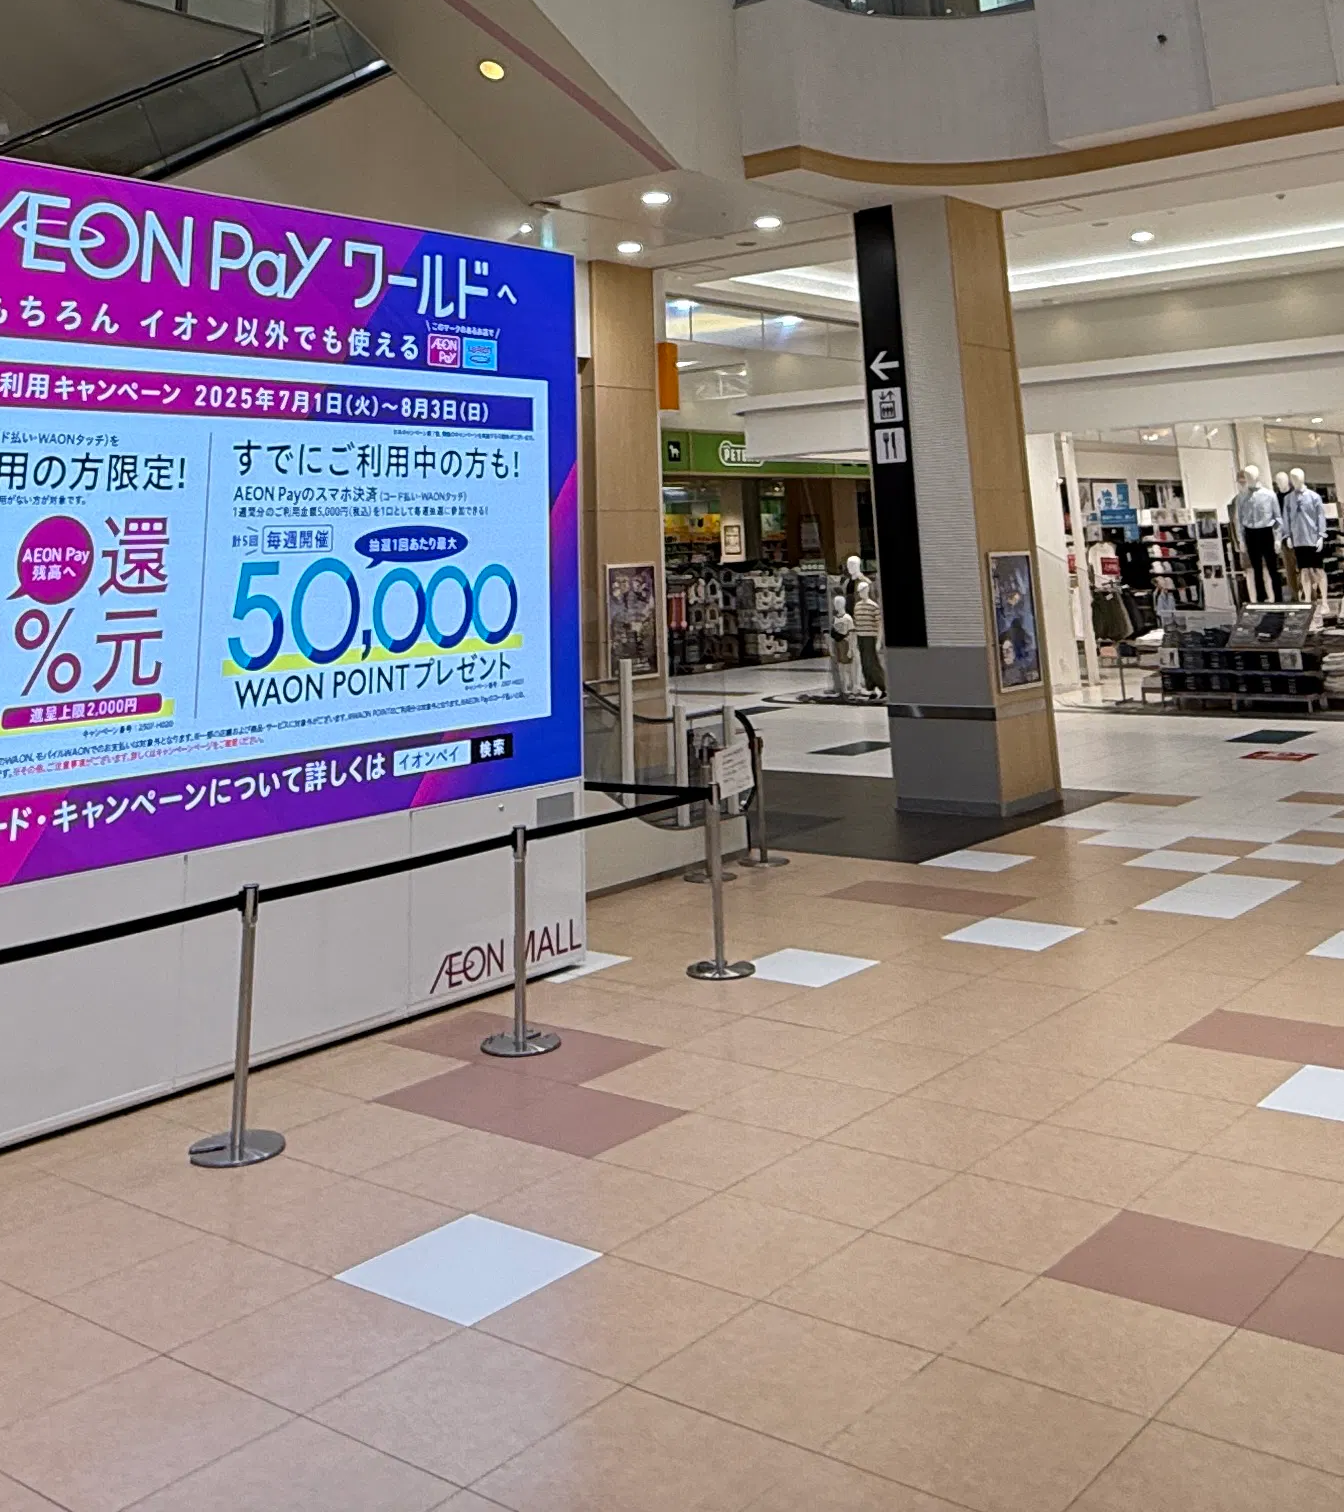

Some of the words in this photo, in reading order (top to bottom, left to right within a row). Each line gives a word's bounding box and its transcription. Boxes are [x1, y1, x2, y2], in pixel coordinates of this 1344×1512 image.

[210, 210, 333, 300] Pay
[140, 308, 420, 363] イオン以外でも使える
[439, 350, 457, 364] Pay
[232, 439, 520, 480] すでにご利用中の方も!
[724, 448, 760, 462] PETE
[233, 486, 275, 502] AEON
[232, 534, 259, 548] 計5回
[267, 530, 330, 550] 毎週開催
[368, 536, 458, 553] 抽選1回あたり最大
[22, 548, 61, 564] AEON
[64, 549, 91, 568] Pay
[31, 564, 77, 582] 残高へ
[227, 556, 519, 672] 50,000
[235, 672, 325, 710] WAON
[29, 696, 139, 725] 進呈上限2,000円
[398, 746, 460, 770] イオンペイ
[479, 738, 506, 759] 検索
